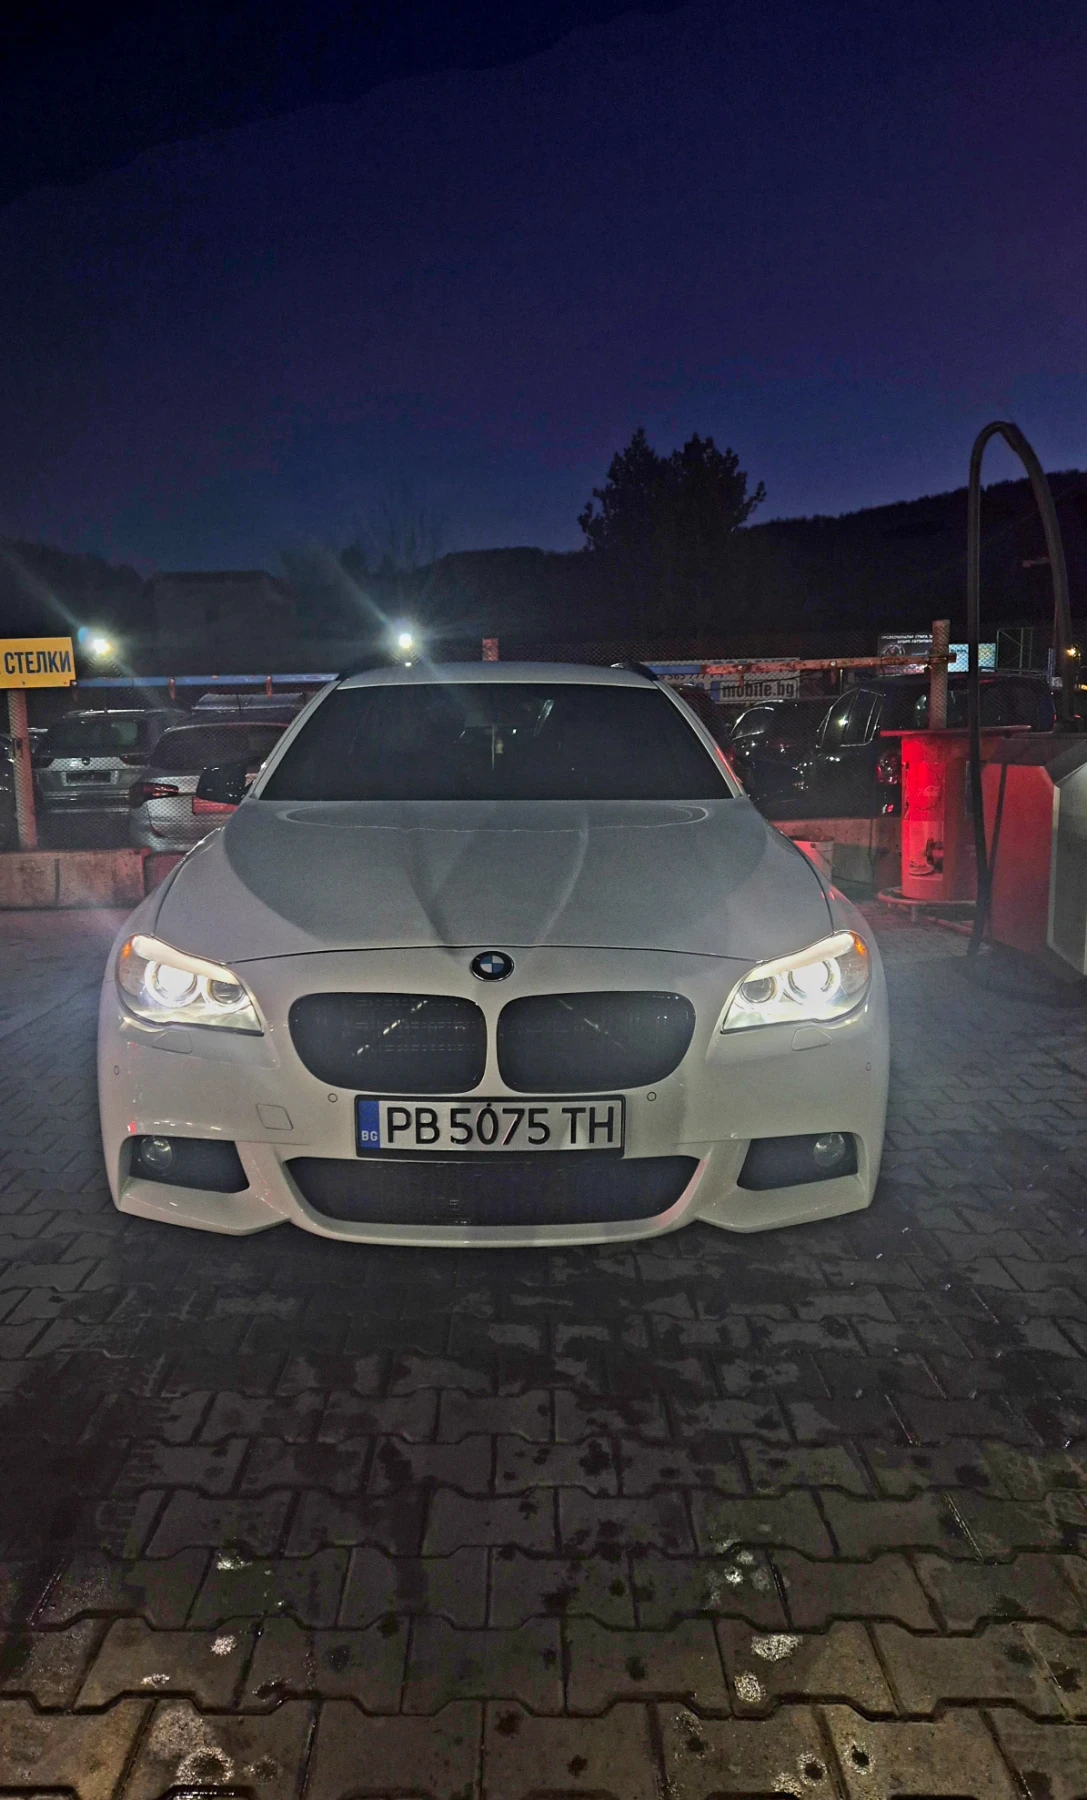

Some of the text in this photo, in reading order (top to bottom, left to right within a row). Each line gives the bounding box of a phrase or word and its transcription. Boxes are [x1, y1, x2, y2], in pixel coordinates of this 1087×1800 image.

[4, 650, 72, 674] СТЕЛКИ
[722, 680, 795, 698] mobile.bg
[361, 1130, 378, 1142] BG
[387, 1106, 615, 1145] PB 5075 TH
